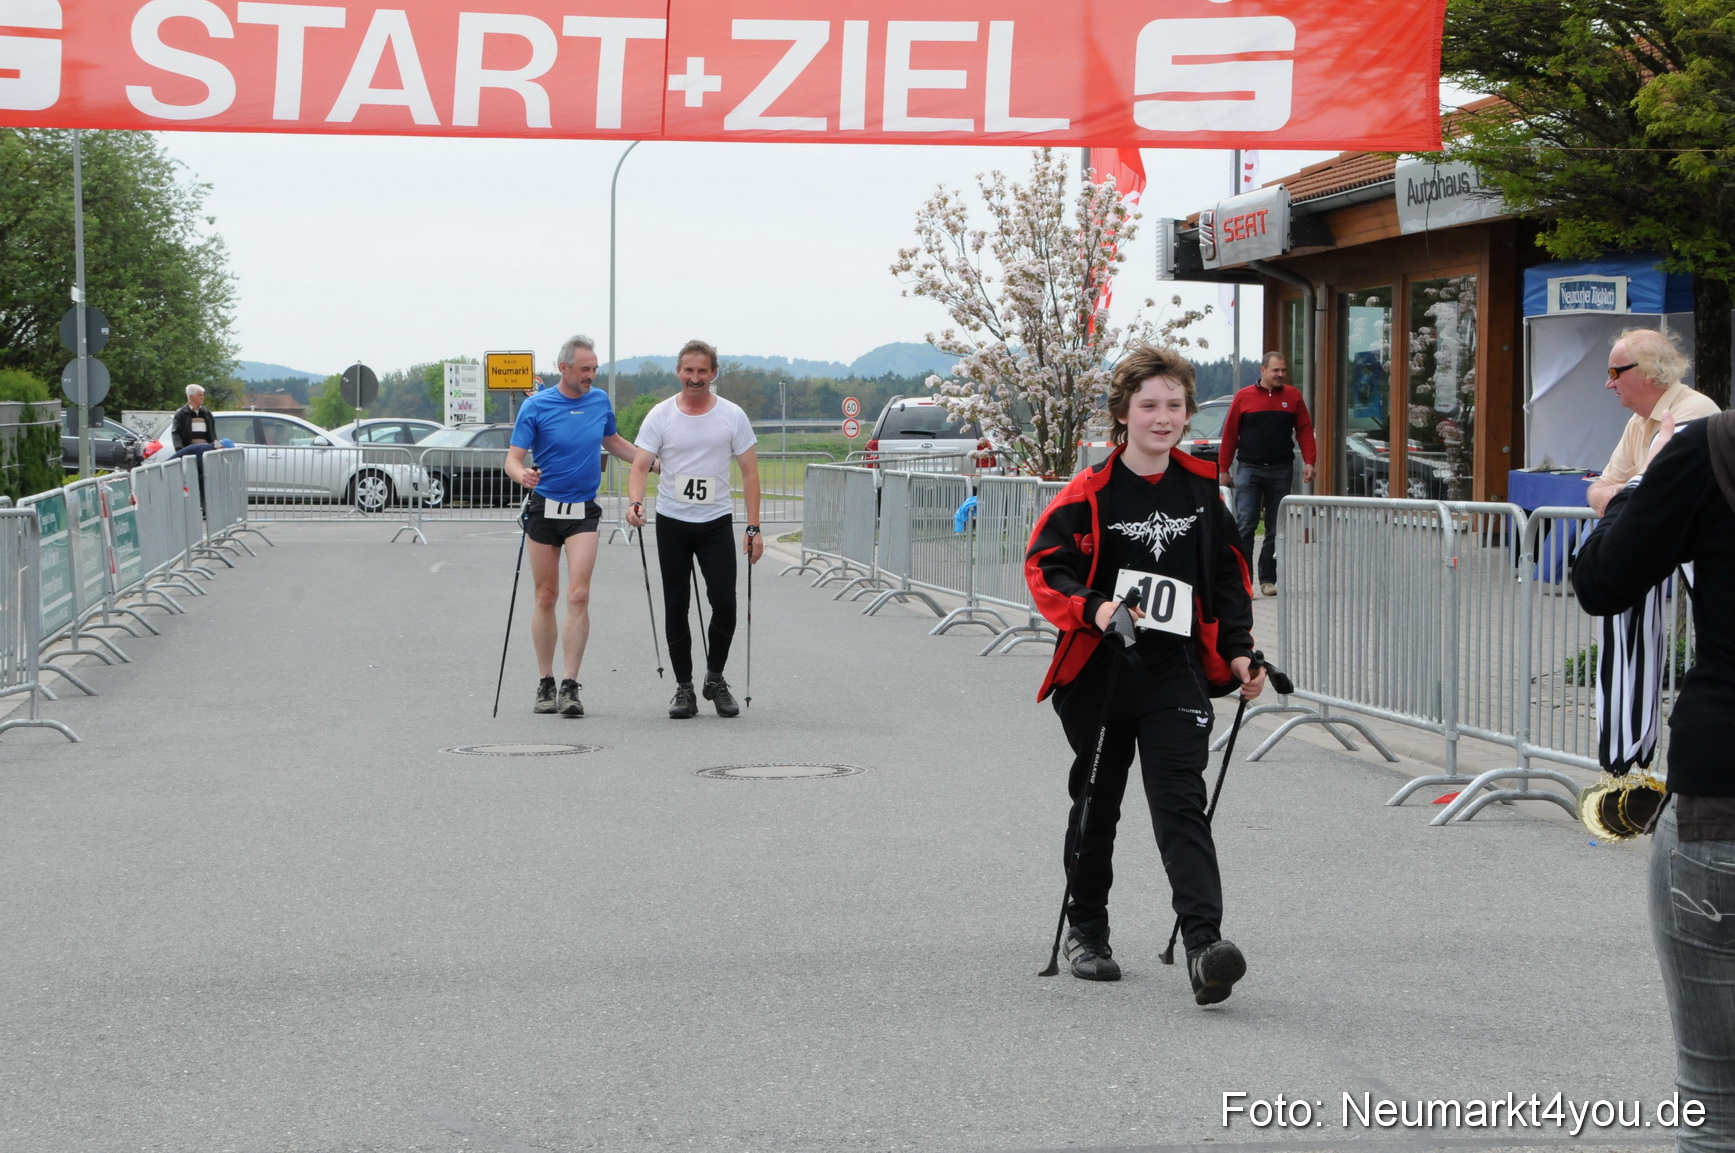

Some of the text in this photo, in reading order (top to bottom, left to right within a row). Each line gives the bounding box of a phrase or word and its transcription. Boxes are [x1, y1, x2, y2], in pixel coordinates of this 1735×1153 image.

[1407, 170, 1470, 207] Autohaus
[1223, 209, 1268, 243] SEAT
[491, 366, 529, 376] Neumarkt
[846, 403, 856, 412] 60
[683, 478, 707, 501] 45
[1137, 576, 1176, 623] 10
[1090, 726, 1106, 784] NORDIC WALKING
